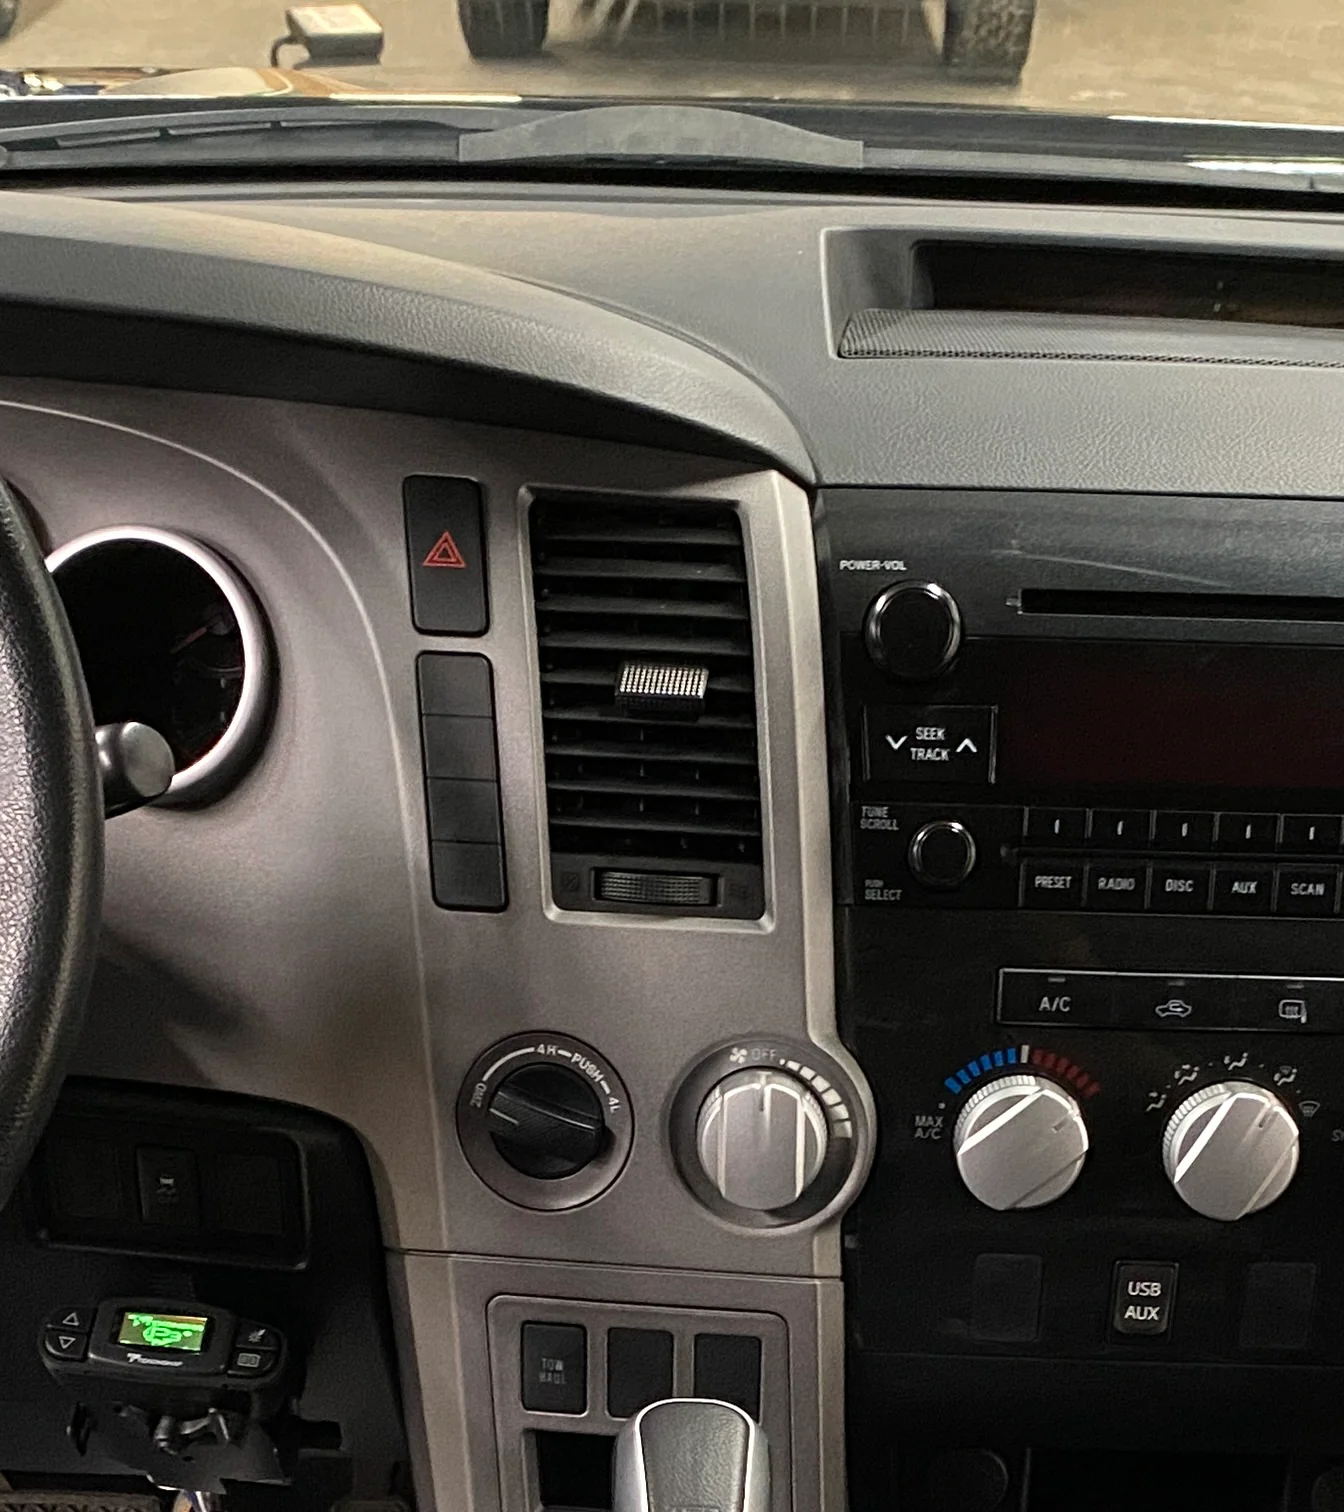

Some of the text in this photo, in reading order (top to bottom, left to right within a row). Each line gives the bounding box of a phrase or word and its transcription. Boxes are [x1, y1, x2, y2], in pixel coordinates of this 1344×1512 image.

[916, 726, 947, 741] SEEK
[909, 747, 951, 761] TRACK
[1034, 875, 1073, 889] PRESET
[1097, 877, 1136, 891] RADIO
[1164, 879, 1195, 892] DISC
[1231, 881, 1258, 894] AUX
[1290, 882, 1326, 896] SCAN
[1038, 996, 1072, 1012] A/C
[751, 1048, 777, 1061] OFF
[536, 1043, 622, 1114] 4H PUSH 4L
[914, 1115, 945, 1128] MAX
[914, 1127, 942, 1140] A/C
[1127, 1281, 1162, 1297] USB
[1123, 1305, 1161, 1321] AUX
